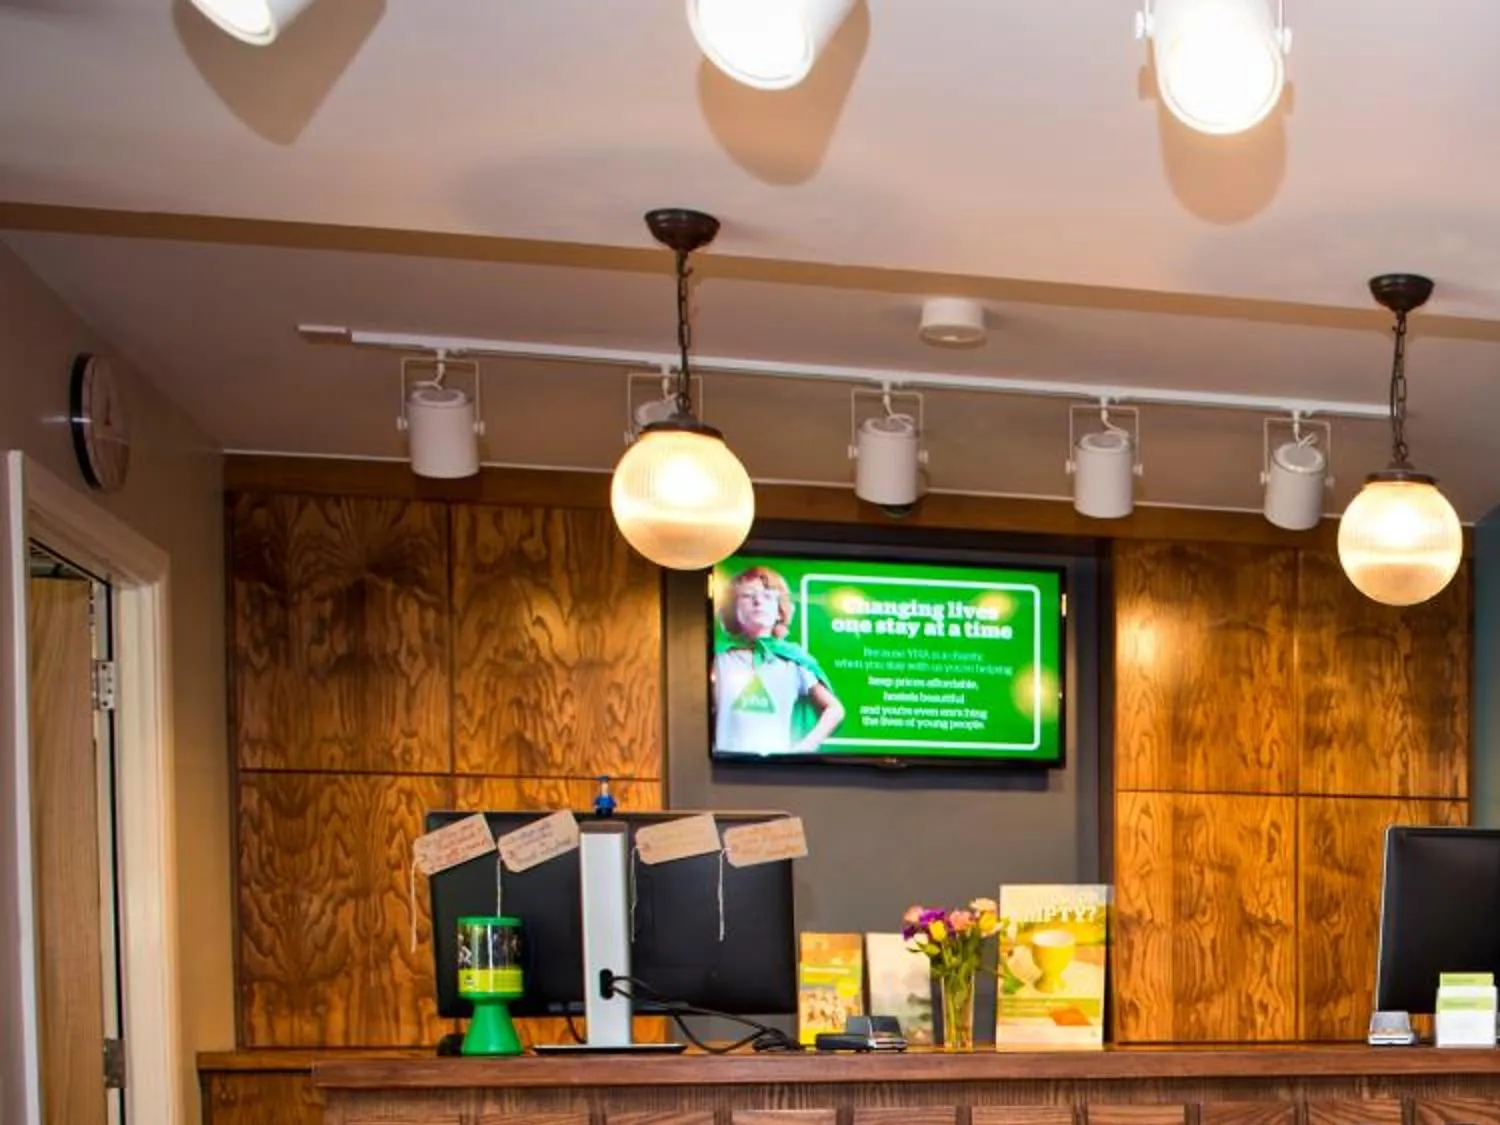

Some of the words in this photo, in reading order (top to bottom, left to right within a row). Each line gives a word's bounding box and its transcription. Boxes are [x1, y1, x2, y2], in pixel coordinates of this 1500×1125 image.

[947, 600, 999, 621] lives
[831, 618, 872, 633] one
[875, 618, 920, 638] stay
[924, 620, 944, 637] at
[948, 624, 961, 637] a
[964, 621, 1013, 640] time
[1008, 897, 1097, 923] MPTY?
